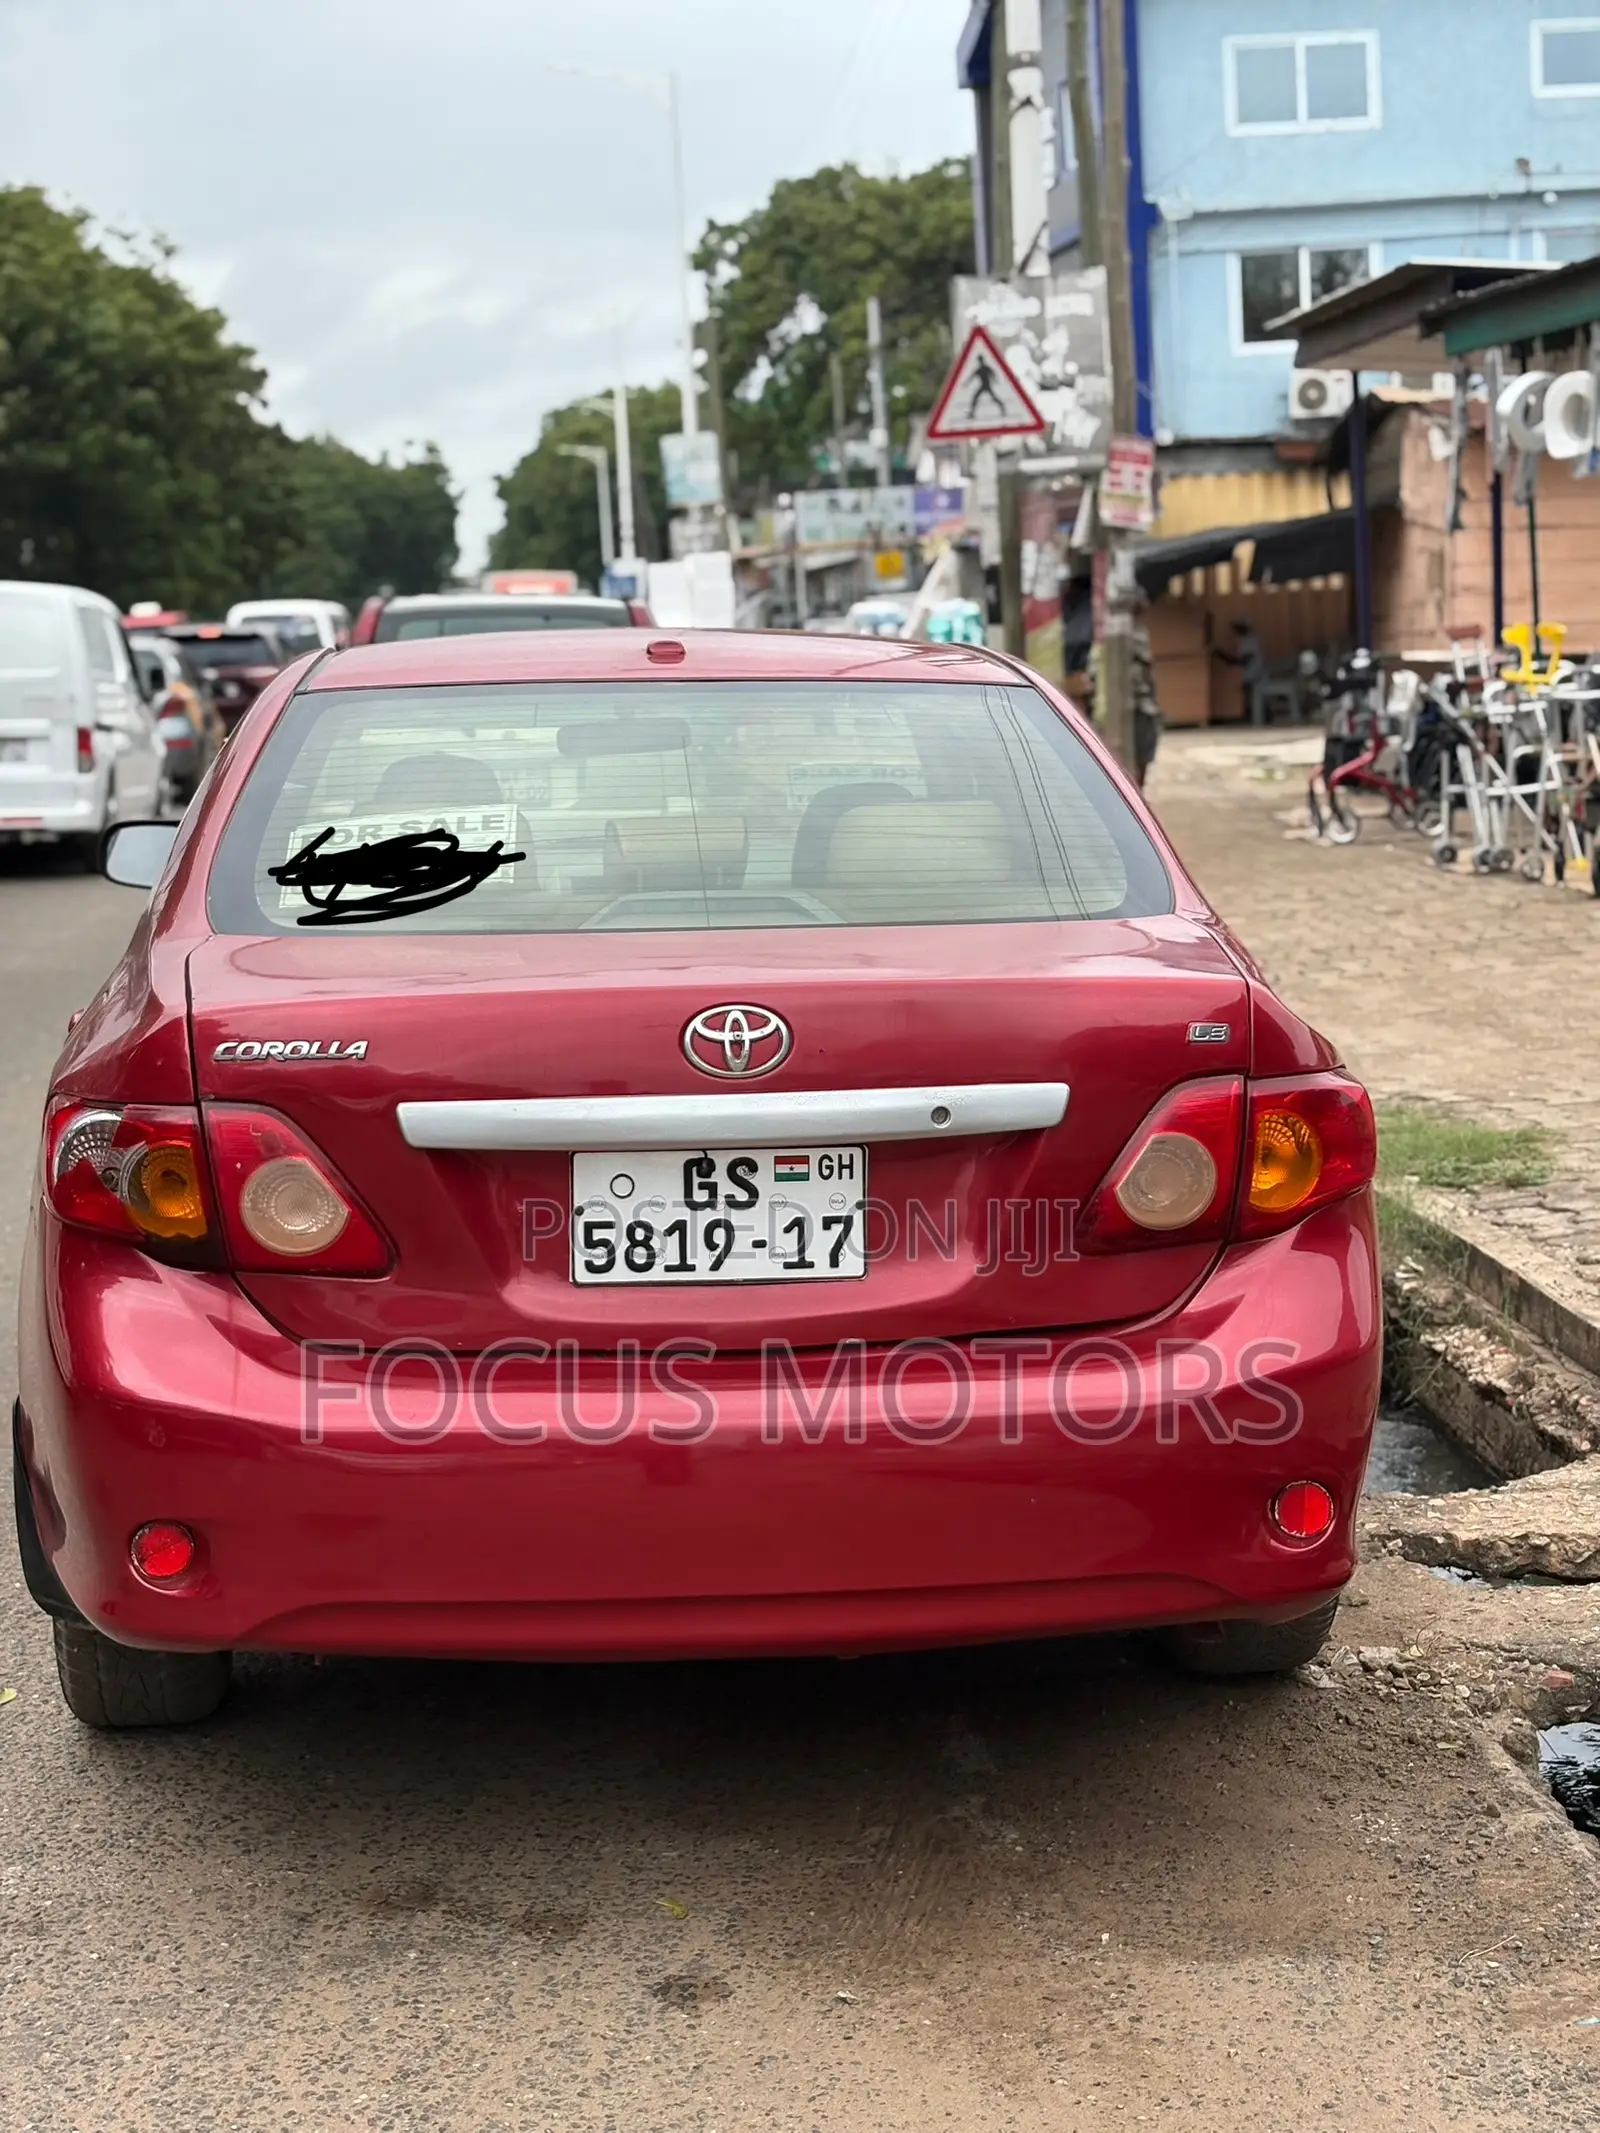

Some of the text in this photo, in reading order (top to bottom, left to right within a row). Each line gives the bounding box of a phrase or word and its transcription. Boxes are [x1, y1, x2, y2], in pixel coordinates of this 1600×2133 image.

[399, 813, 506, 836] SALE
[213, 1040, 369, 1061] COROLLA
[817, 1152, 854, 1181] GH
[683, 1156, 760, 1211] GS
